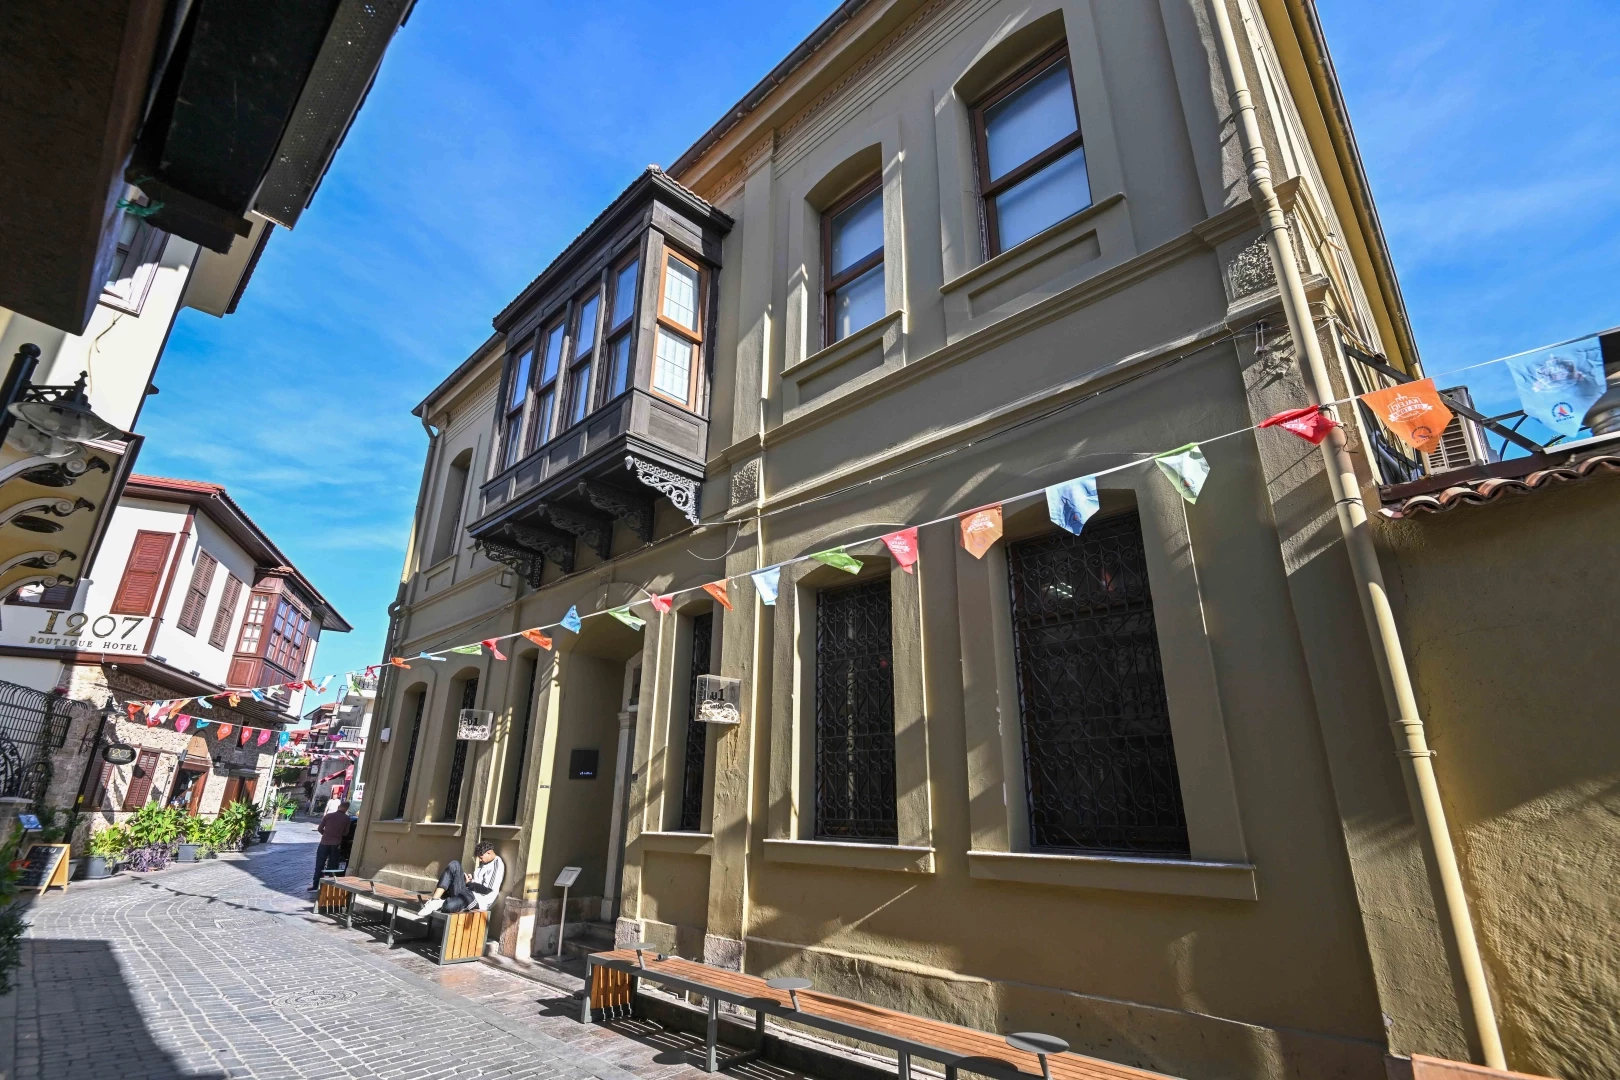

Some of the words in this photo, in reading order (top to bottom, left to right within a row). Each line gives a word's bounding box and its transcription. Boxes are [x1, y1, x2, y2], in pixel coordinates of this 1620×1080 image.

[38, 610, 144, 640] 1207
[28, 636, 93, 648] BOUTIQUE
[103, 641, 138, 651] HOTEL
